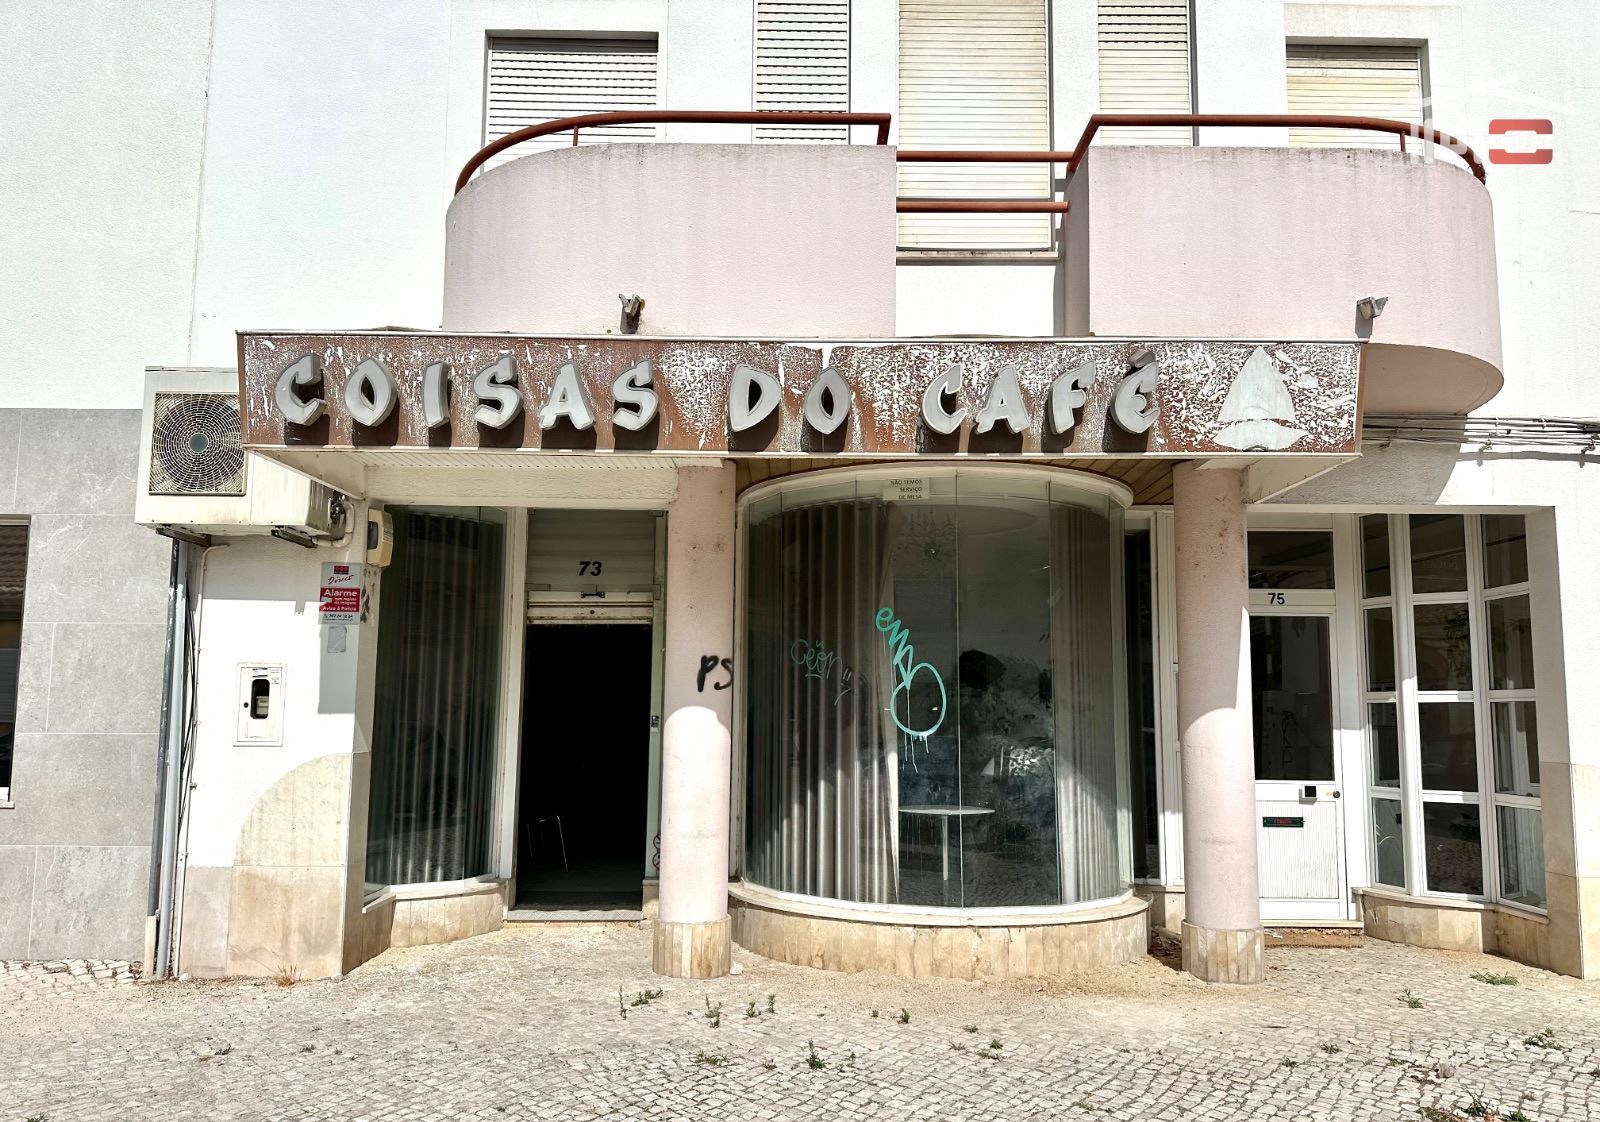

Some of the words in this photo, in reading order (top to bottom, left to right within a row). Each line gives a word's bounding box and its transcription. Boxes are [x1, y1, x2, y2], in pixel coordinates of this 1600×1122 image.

[274, 352, 660, 432] COISAS
[728, 363, 852, 435] DO
[920, 351, 1160, 435] CAFÉ
[579, 561, 602, 577] 73
[323, 588, 358, 597] Alarme
[1267, 592, 1285, 605] 75
